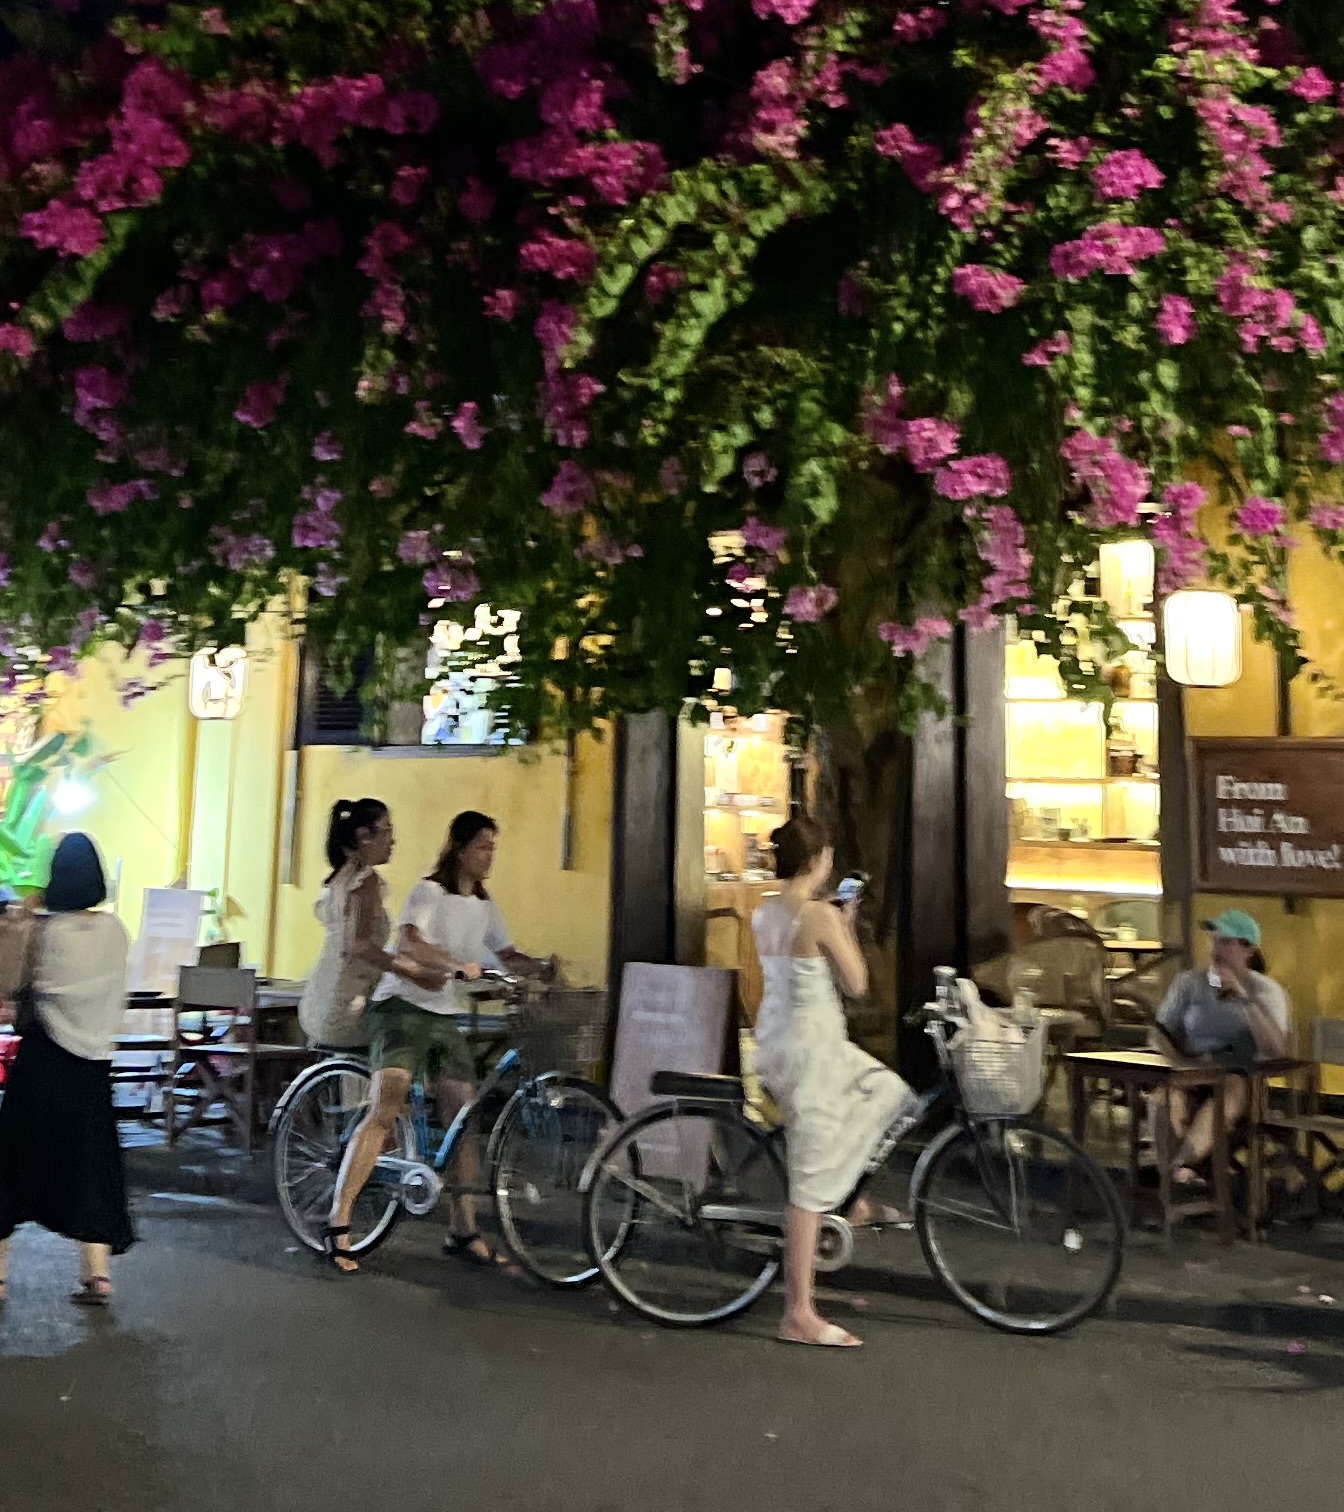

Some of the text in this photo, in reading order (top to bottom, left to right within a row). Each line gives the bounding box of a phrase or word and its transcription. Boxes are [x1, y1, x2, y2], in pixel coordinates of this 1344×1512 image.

[1215, 774, 1289, 801] From
[1217, 840, 1343, 869] with love!
